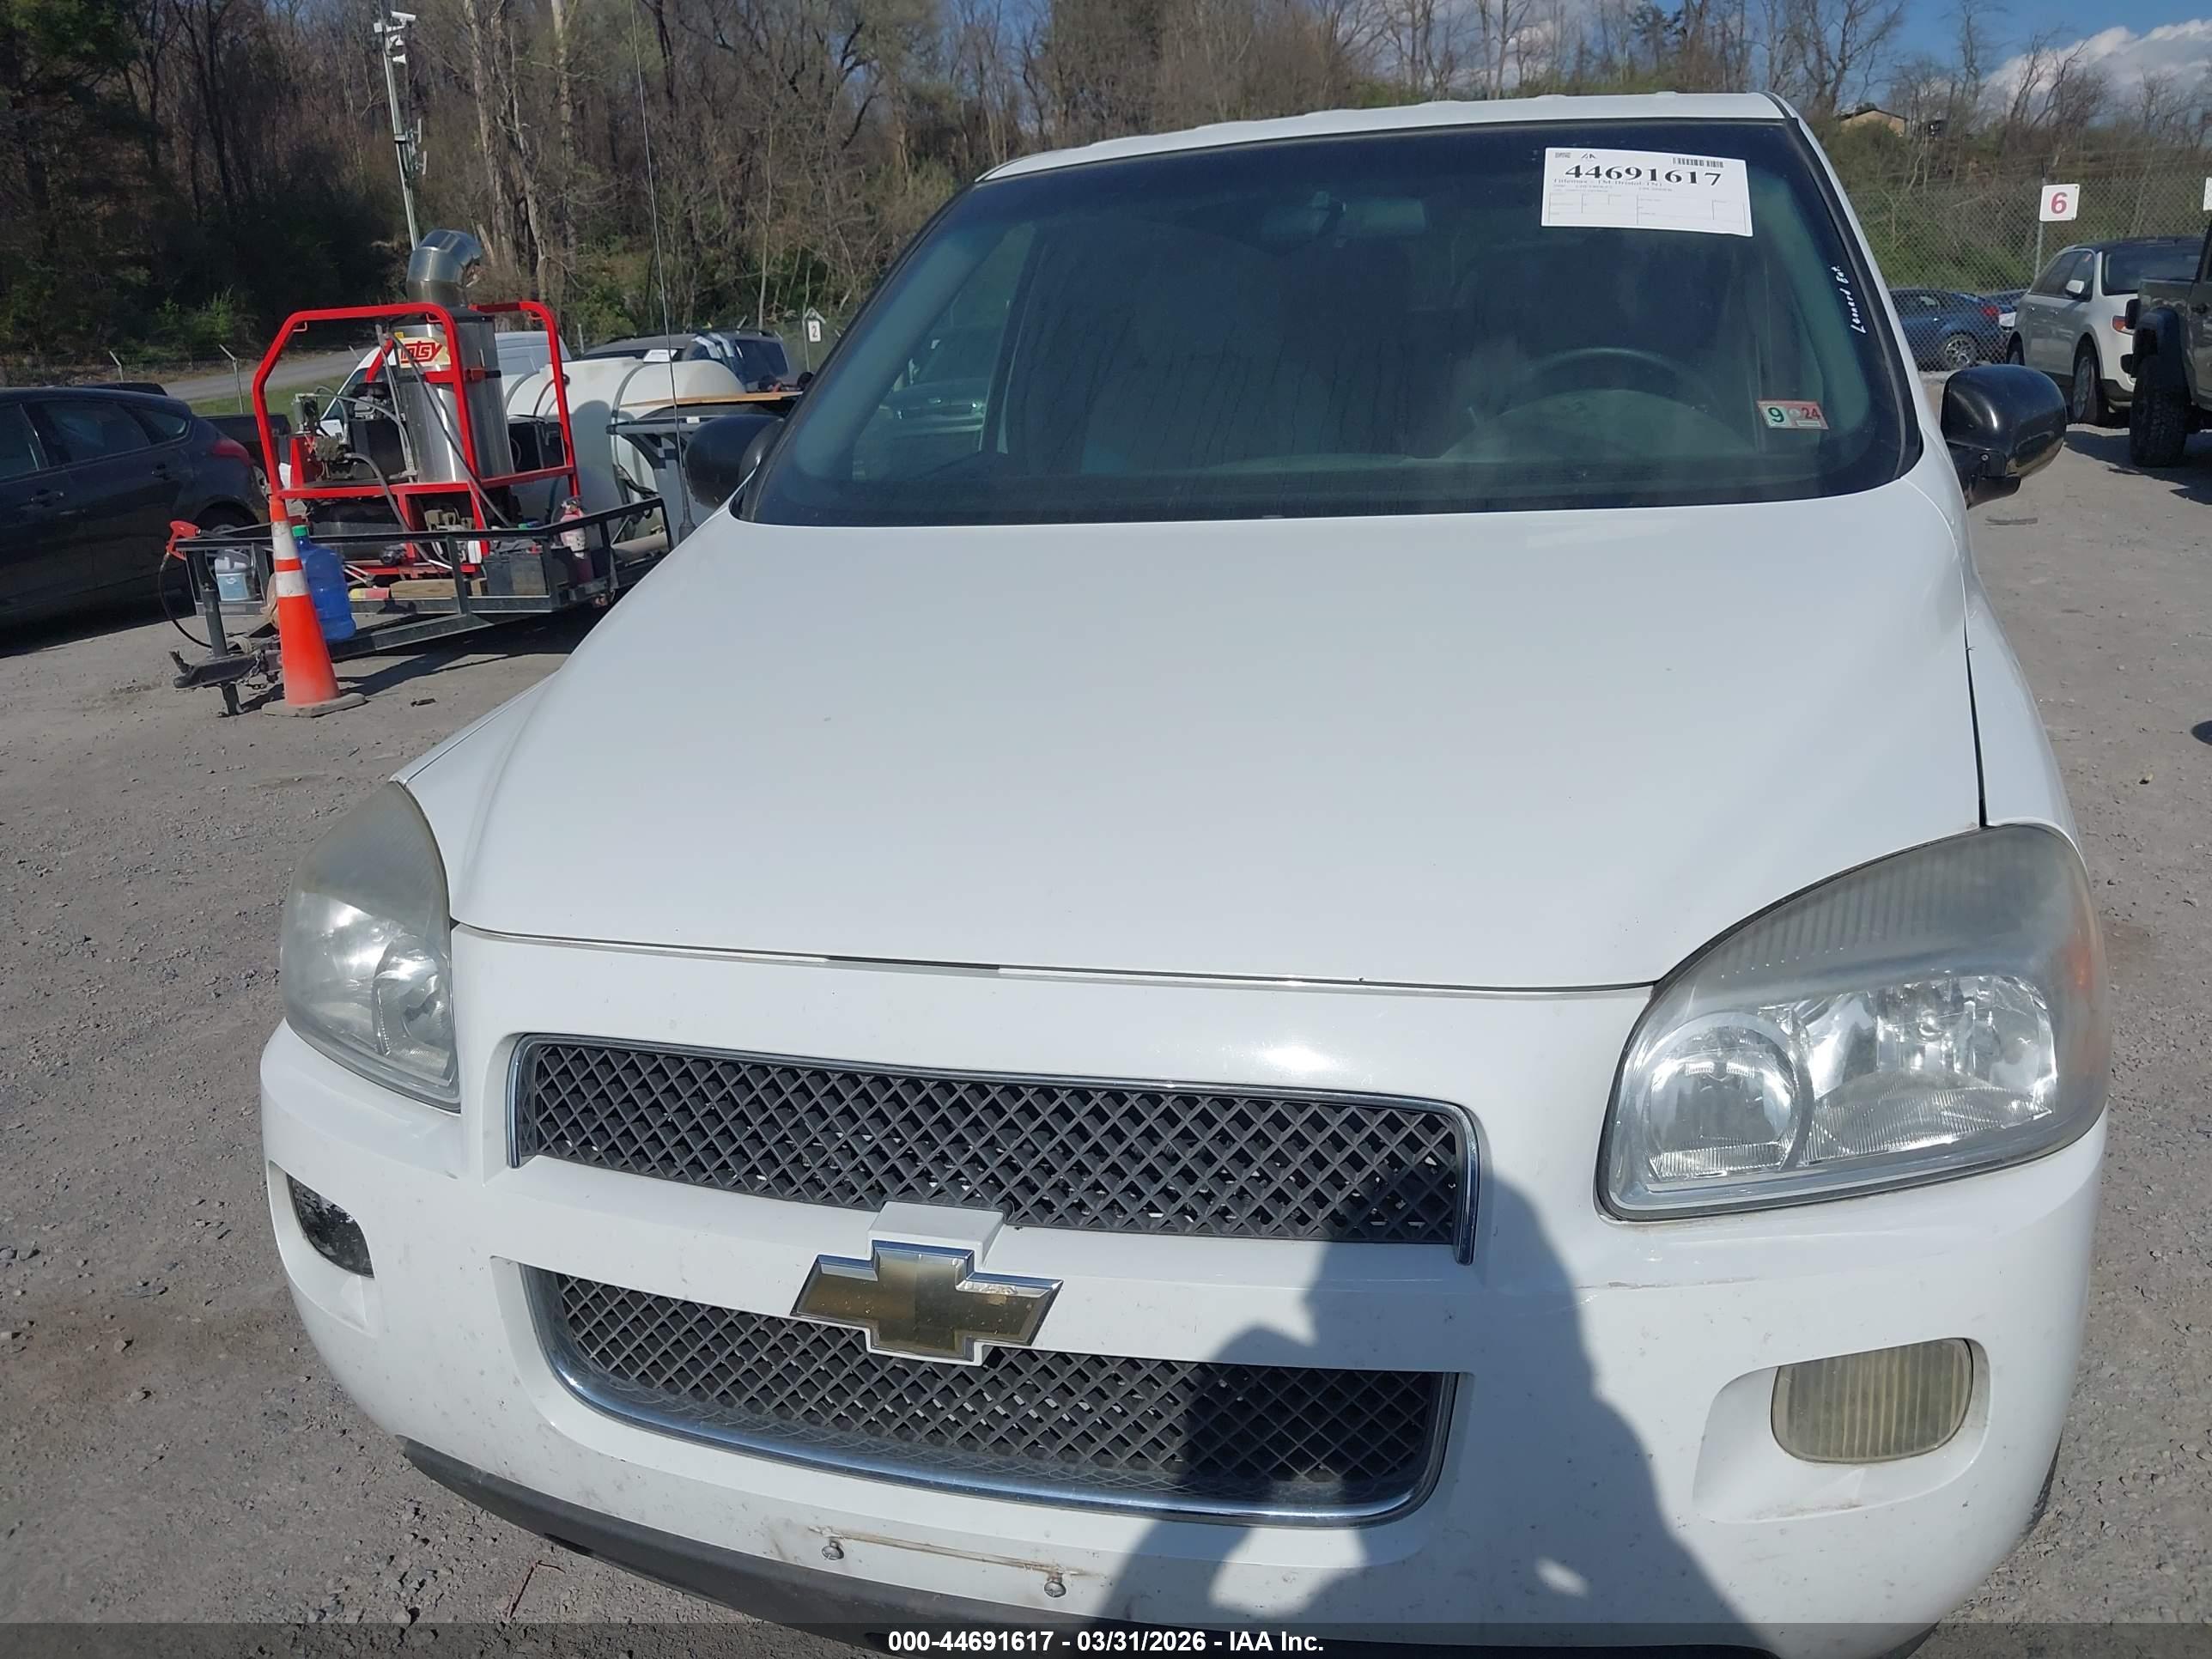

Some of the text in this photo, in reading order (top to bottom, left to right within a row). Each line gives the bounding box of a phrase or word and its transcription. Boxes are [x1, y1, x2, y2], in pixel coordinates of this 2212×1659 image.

[1565, 163, 1723, 186] 44691617
[2051, 191, 2068, 215] 6
[811, 325, 818, 338] 2
[1767, 406, 1820, 423] 9 24
